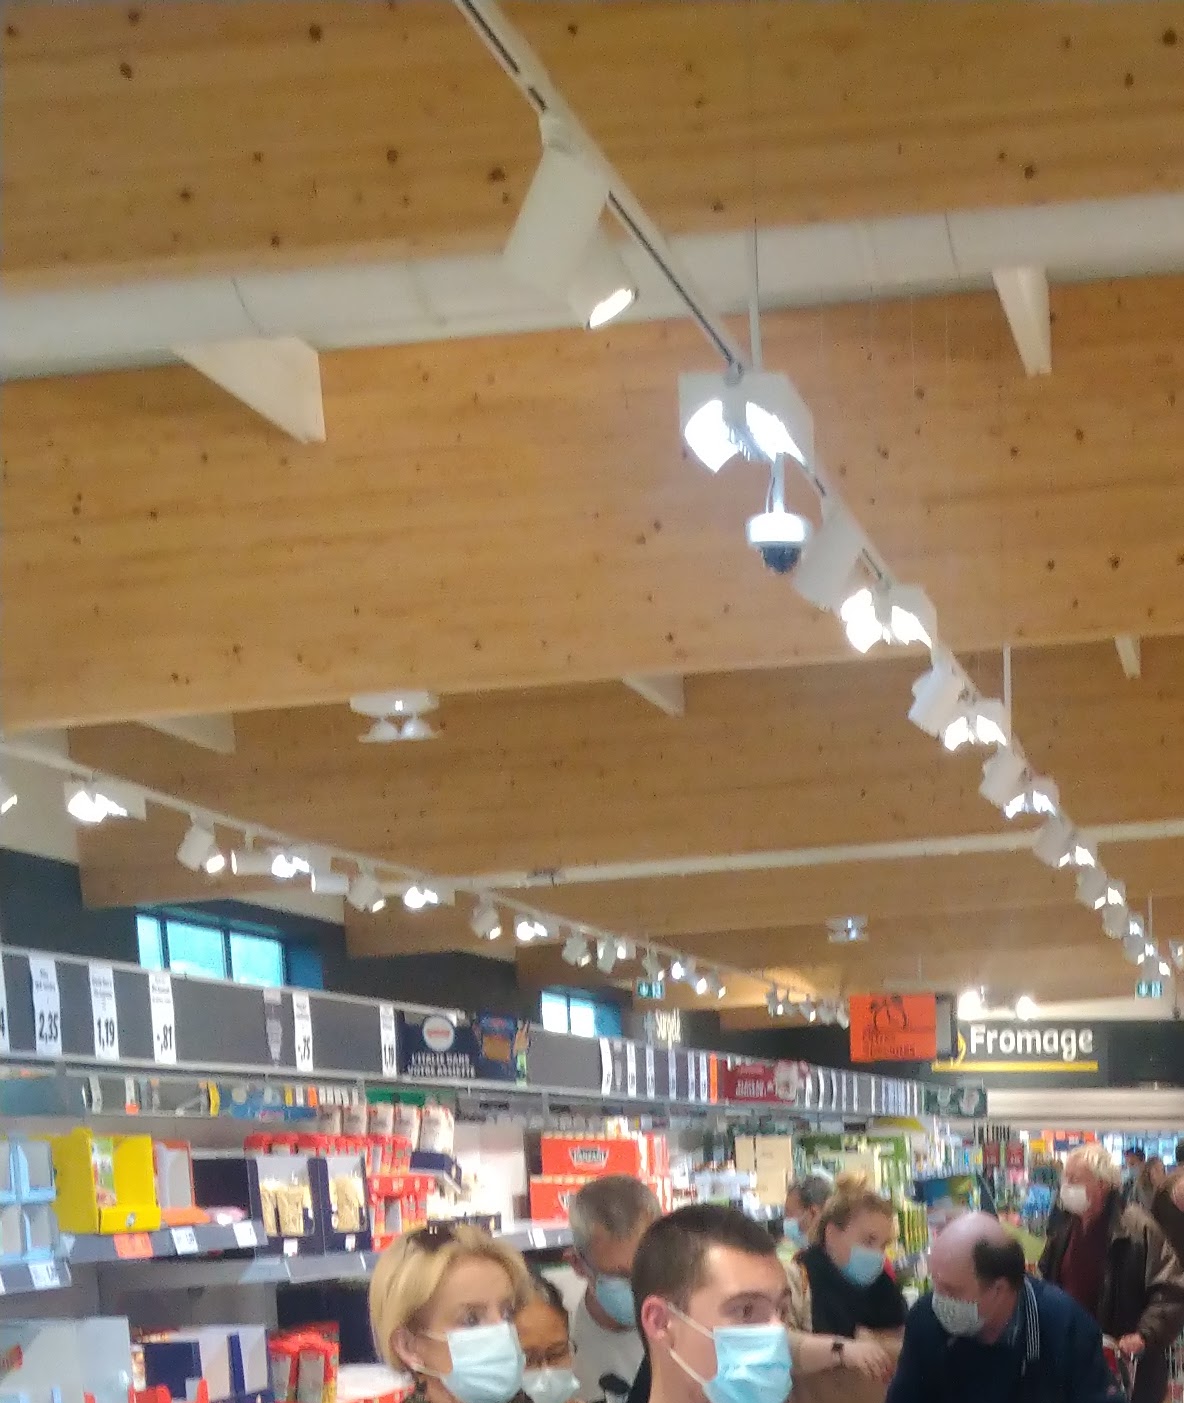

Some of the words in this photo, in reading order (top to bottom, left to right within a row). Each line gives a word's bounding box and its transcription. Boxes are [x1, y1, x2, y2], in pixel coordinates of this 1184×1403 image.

[38, 1011, 59, 1044] 2,35
[96, 1017, 116, 1051] 1,19
[969, 1023, 1094, 1063] Fromage
